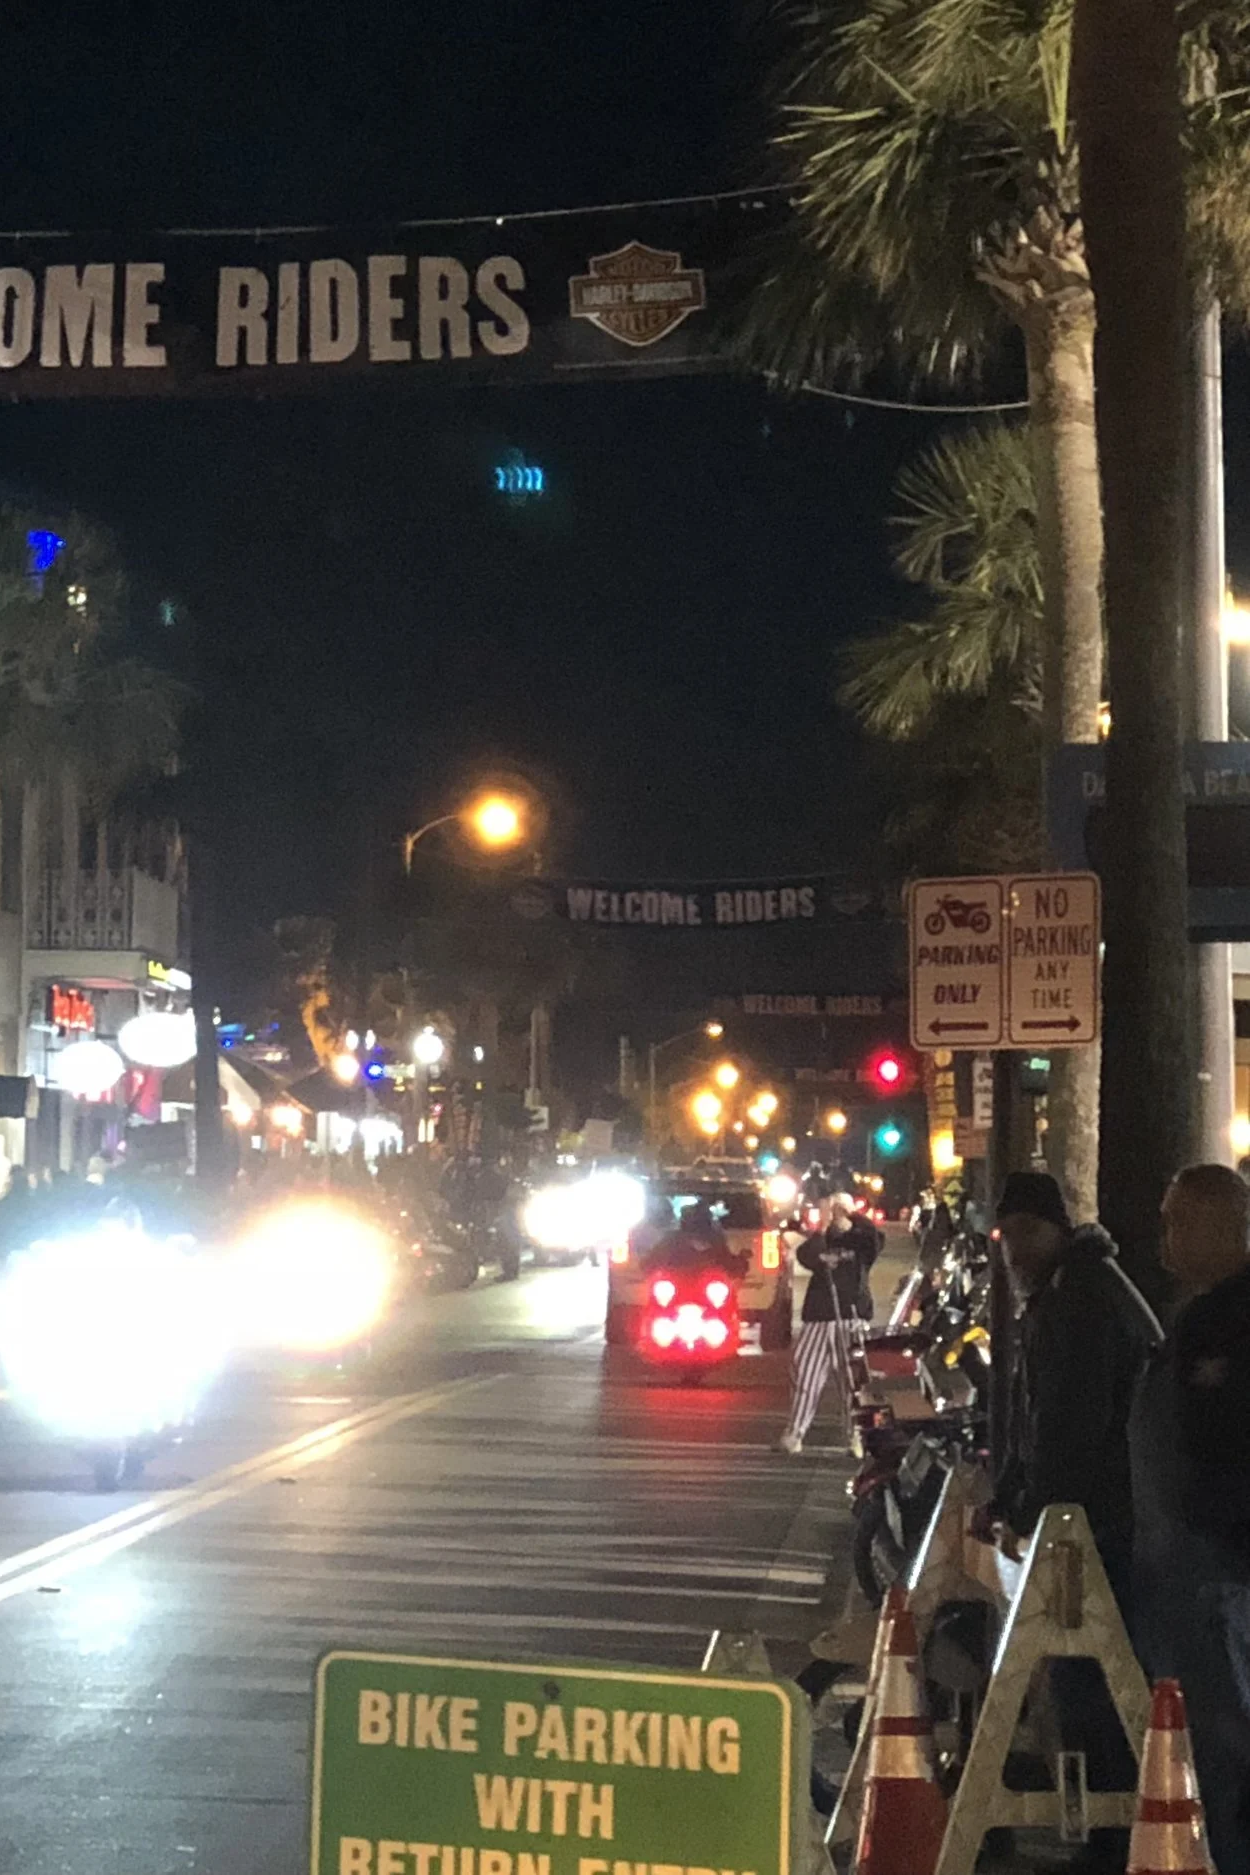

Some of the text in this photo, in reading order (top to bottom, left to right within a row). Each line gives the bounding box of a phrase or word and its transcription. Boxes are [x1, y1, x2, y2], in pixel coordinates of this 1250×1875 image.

[216, 255, 530, 366] RIDERS
[567, 887, 815, 925] WELCOME RIDERS
[1034, 888, 1068, 919] NO
[917, 944, 999, 967] PARKING
[1012, 924, 1092, 957] PARKING
[1034, 961, 1069, 982] ANY
[933, 984, 981, 1005] ONLY
[1031, 988, 1073, 1009] TIME
[358, 1689, 741, 1775] BIKE PARKING
[474, 1773, 615, 1841] WITH
